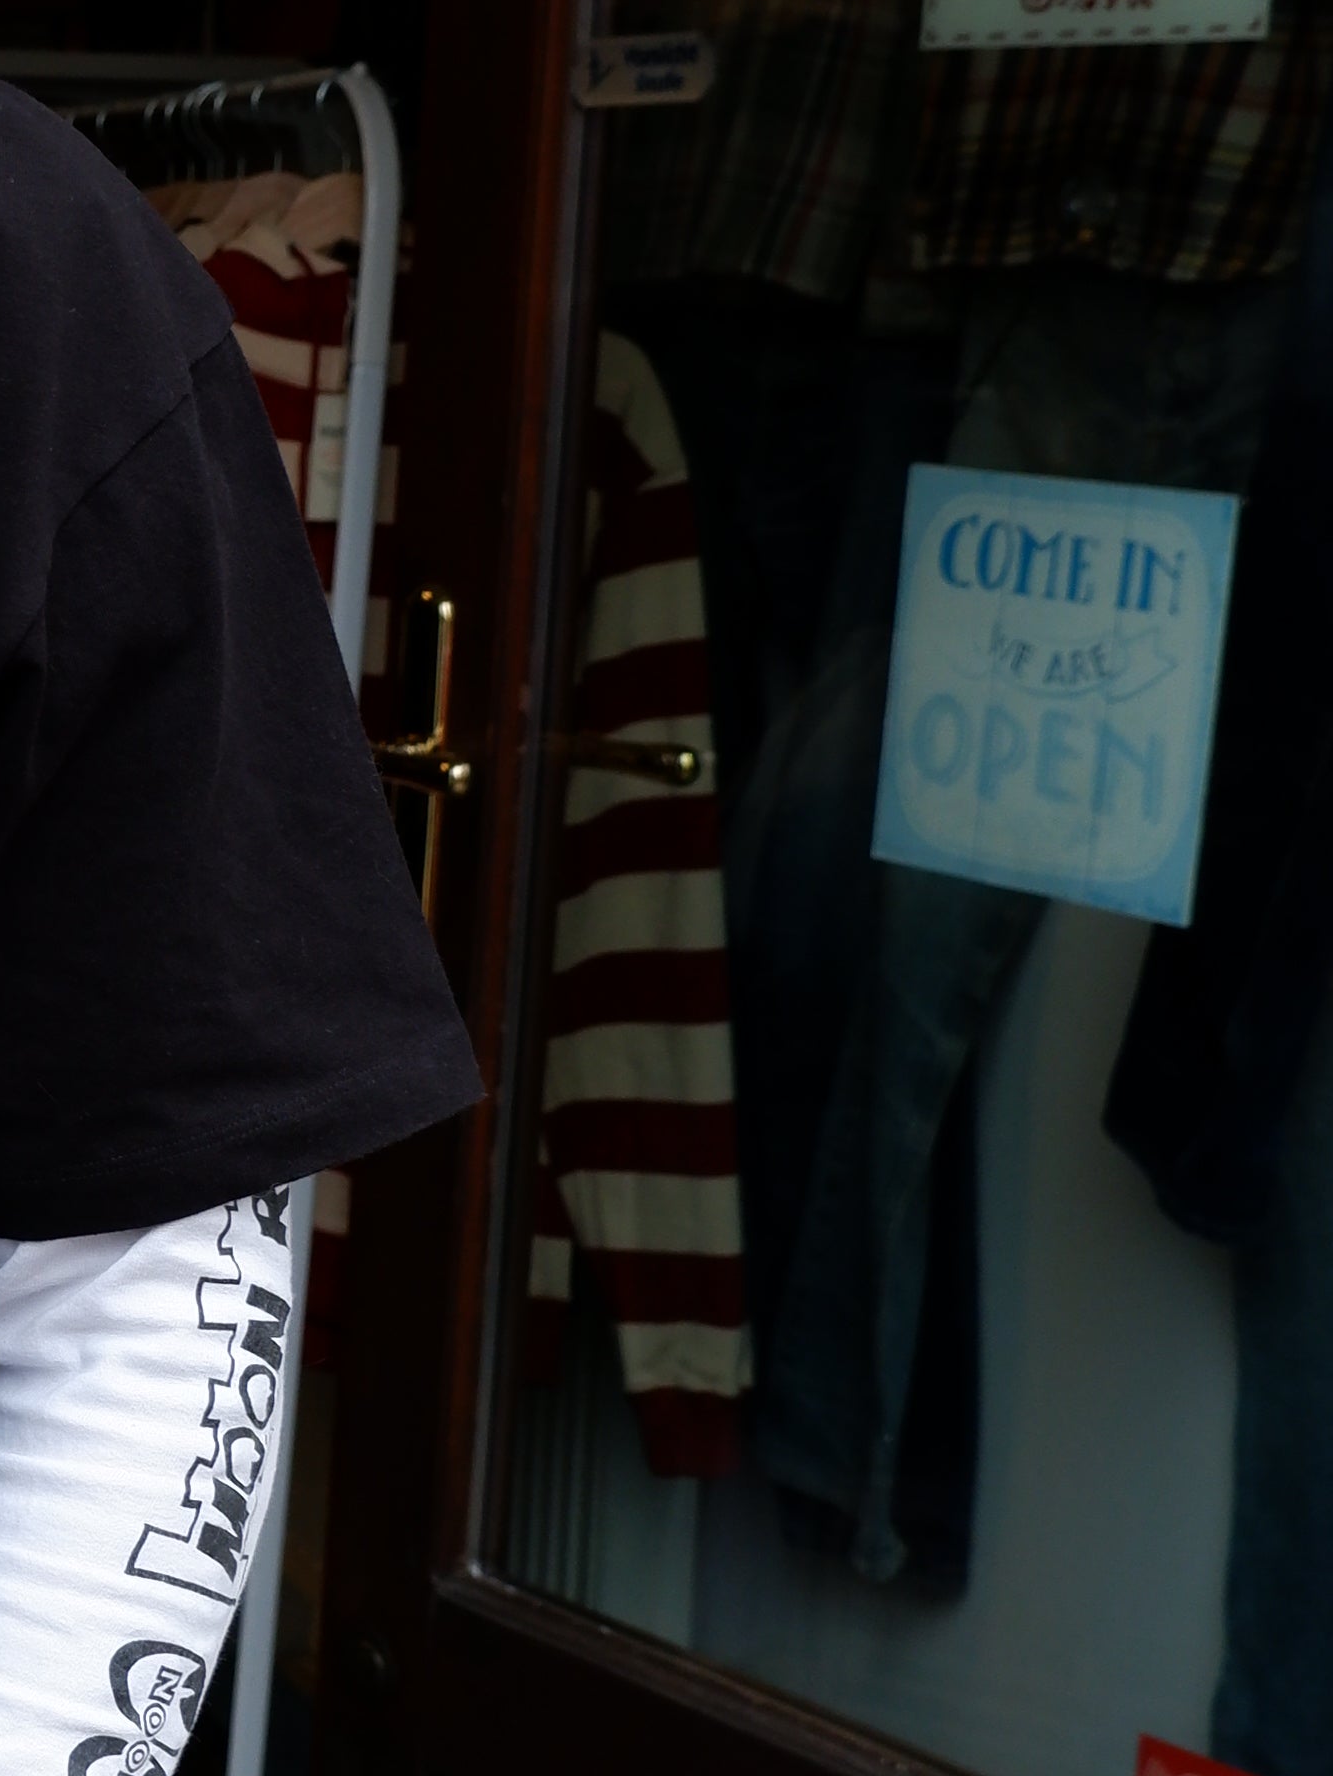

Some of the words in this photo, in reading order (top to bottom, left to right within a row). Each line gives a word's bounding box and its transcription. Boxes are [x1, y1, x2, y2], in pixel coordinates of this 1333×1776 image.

[938, 512, 1098, 606] COME
[1116, 539, 1186, 616] IN
[1042, 643, 1112, 686] ARE
[910, 692, 1165, 824] OPEN
[196, 1283, 290, 1571] MOON
